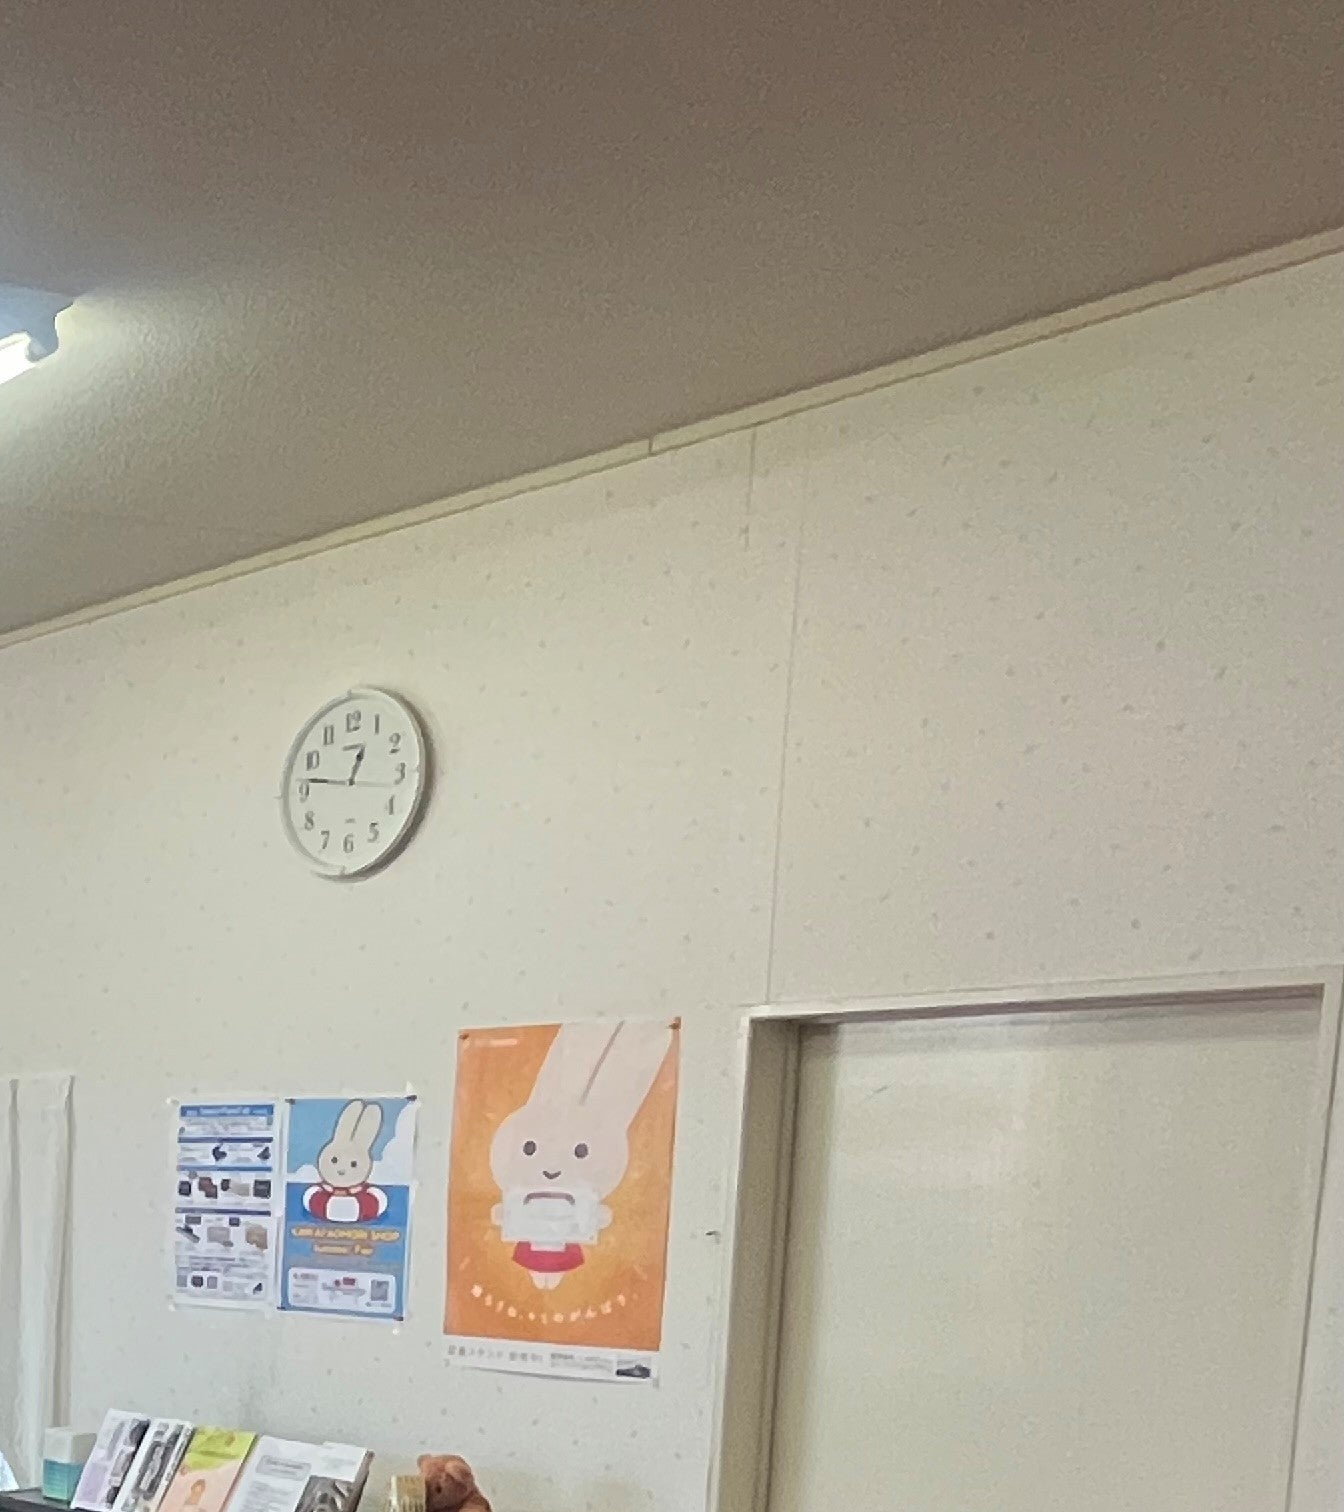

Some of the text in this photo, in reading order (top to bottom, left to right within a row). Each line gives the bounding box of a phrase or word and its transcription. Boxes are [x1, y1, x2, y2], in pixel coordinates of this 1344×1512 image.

[373, 713, 380, 735] 1
[322, 724, 334, 746] 11
[388, 732, 401, 754] 2
[304, 811, 314, 831] 8
[320, 830, 330, 850] 7
[367, 822, 380, 843] 5
[342, 834, 354, 854] 6
